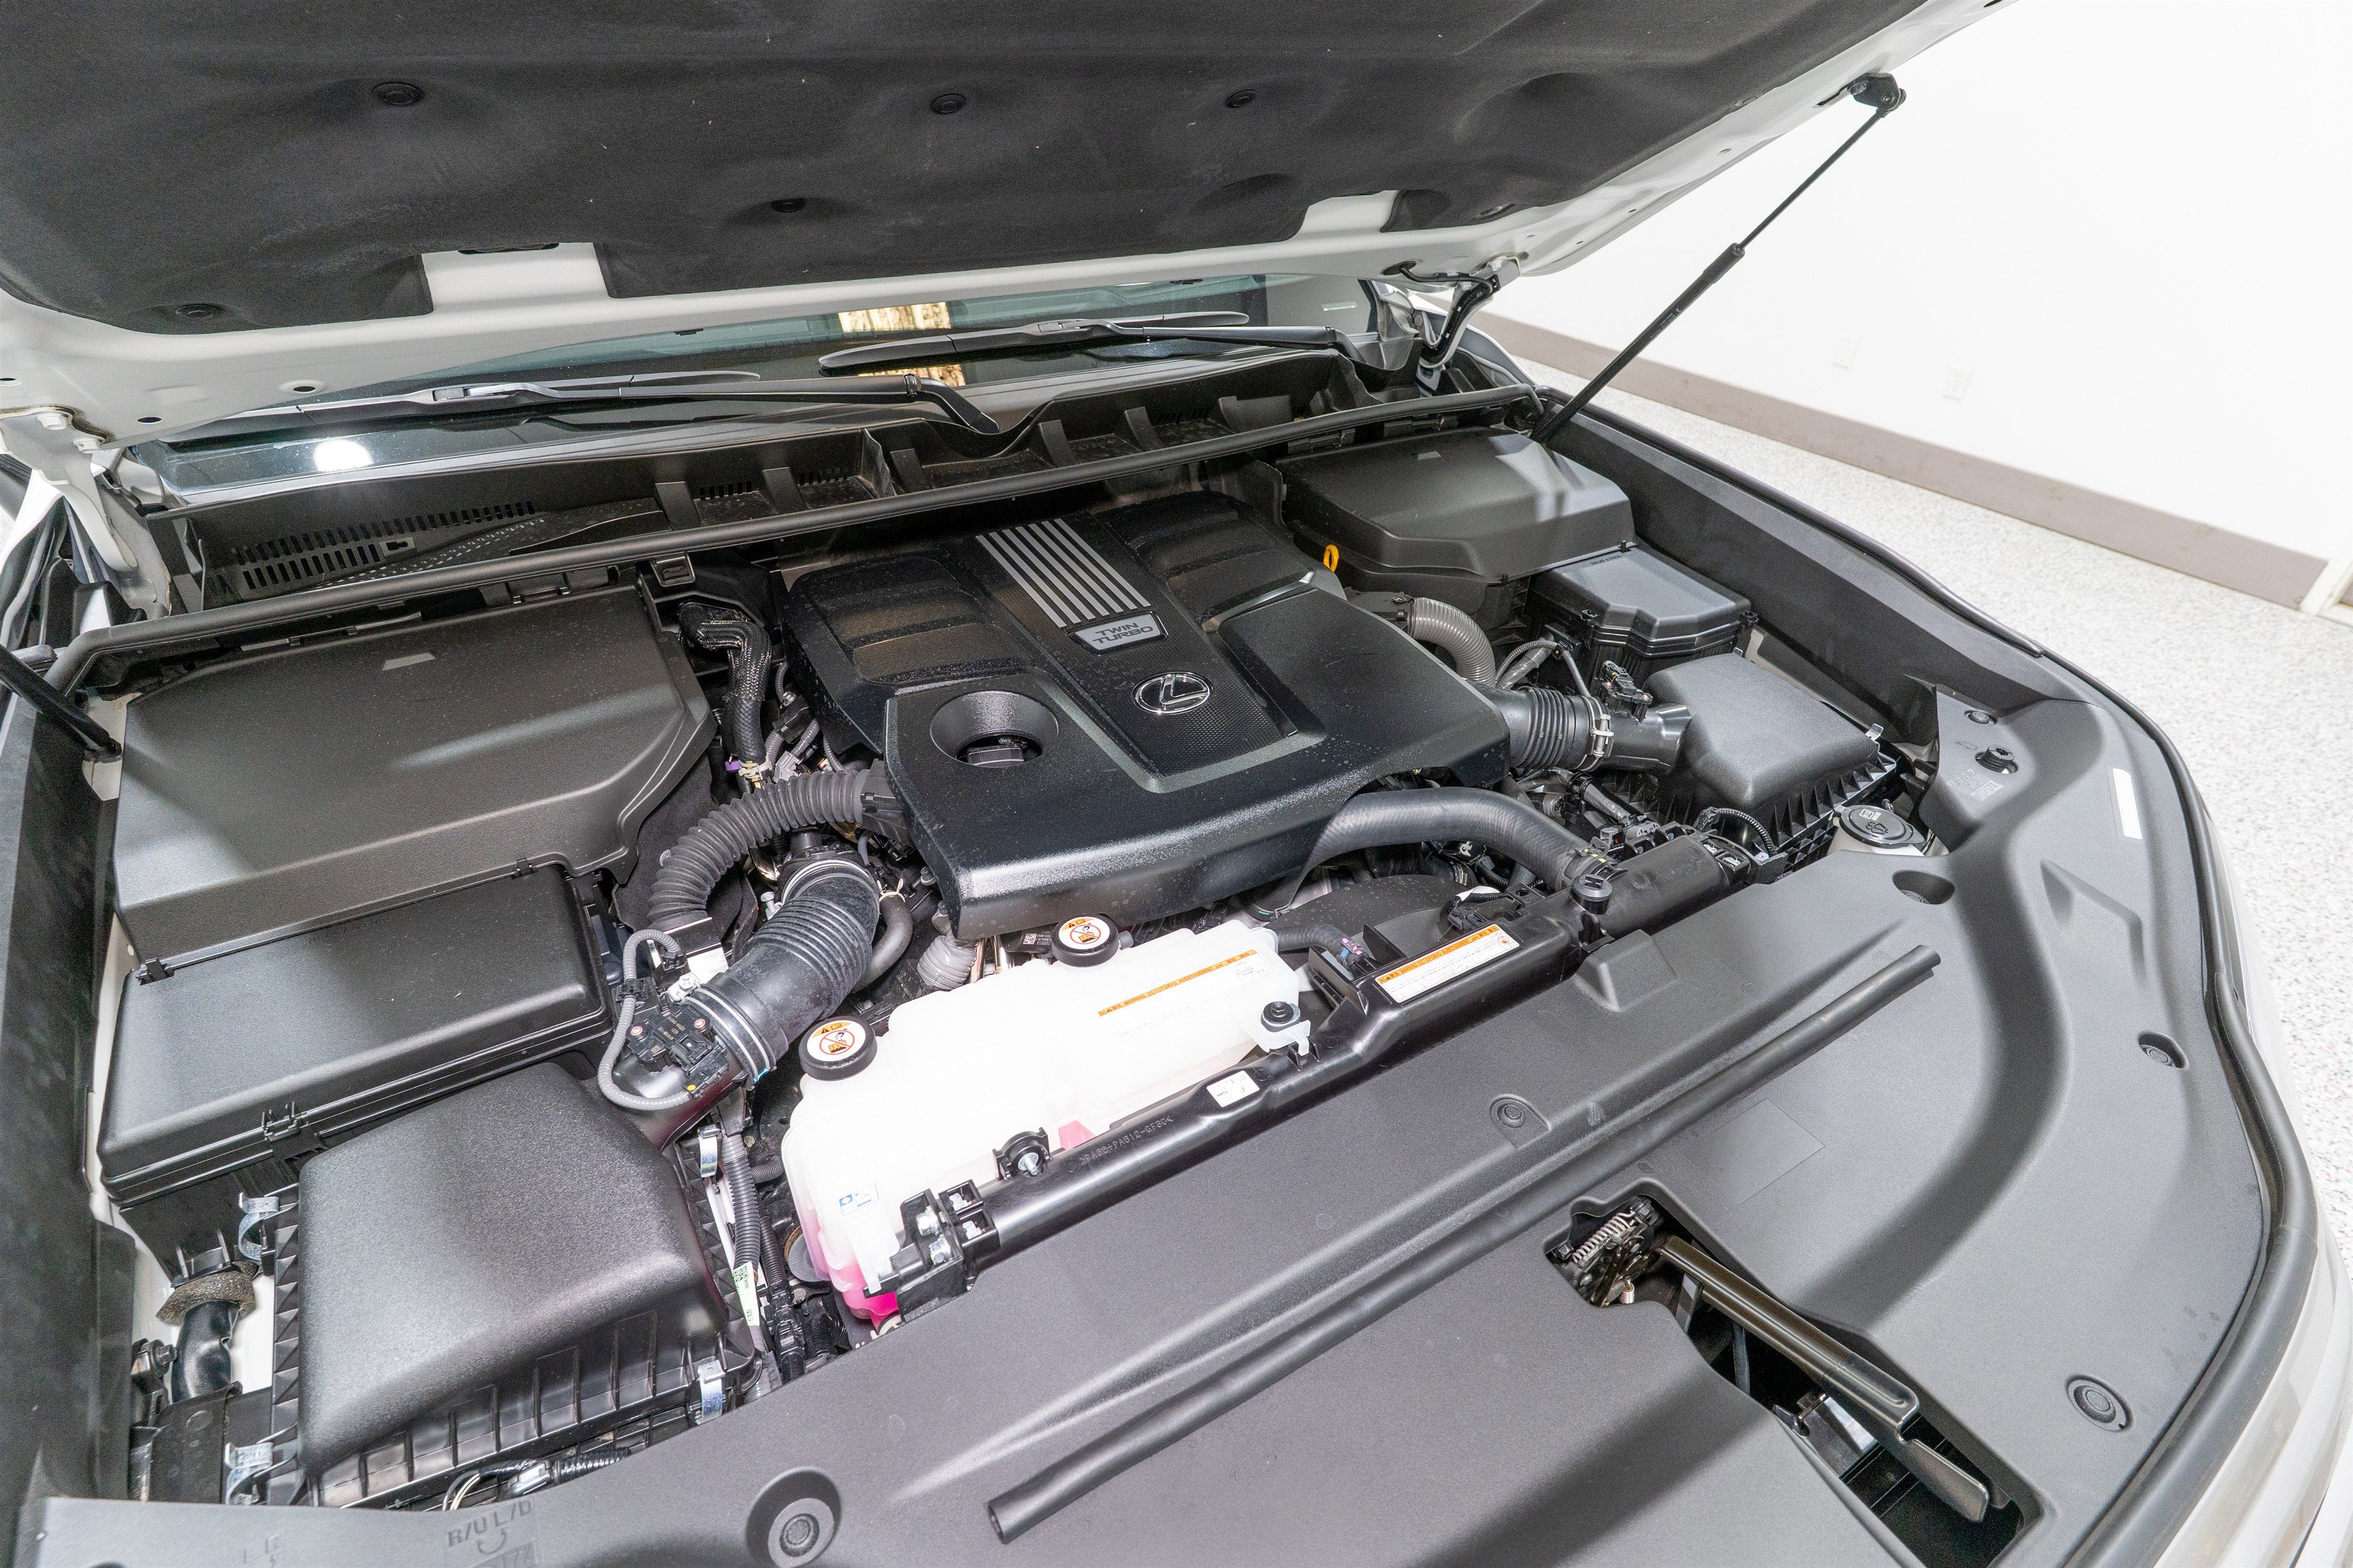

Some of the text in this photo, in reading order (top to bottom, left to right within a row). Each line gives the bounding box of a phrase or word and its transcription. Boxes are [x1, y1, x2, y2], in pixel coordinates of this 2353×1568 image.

[1093, 626, 1153, 643] TURBO
[1096, 623, 1139, 636] TWIN
[1400, 963, 1418, 974] WARNING
[1124, 994, 1146, 1005] WARNING
[1179, 966, 1213, 983] AVERTISSEMENT
